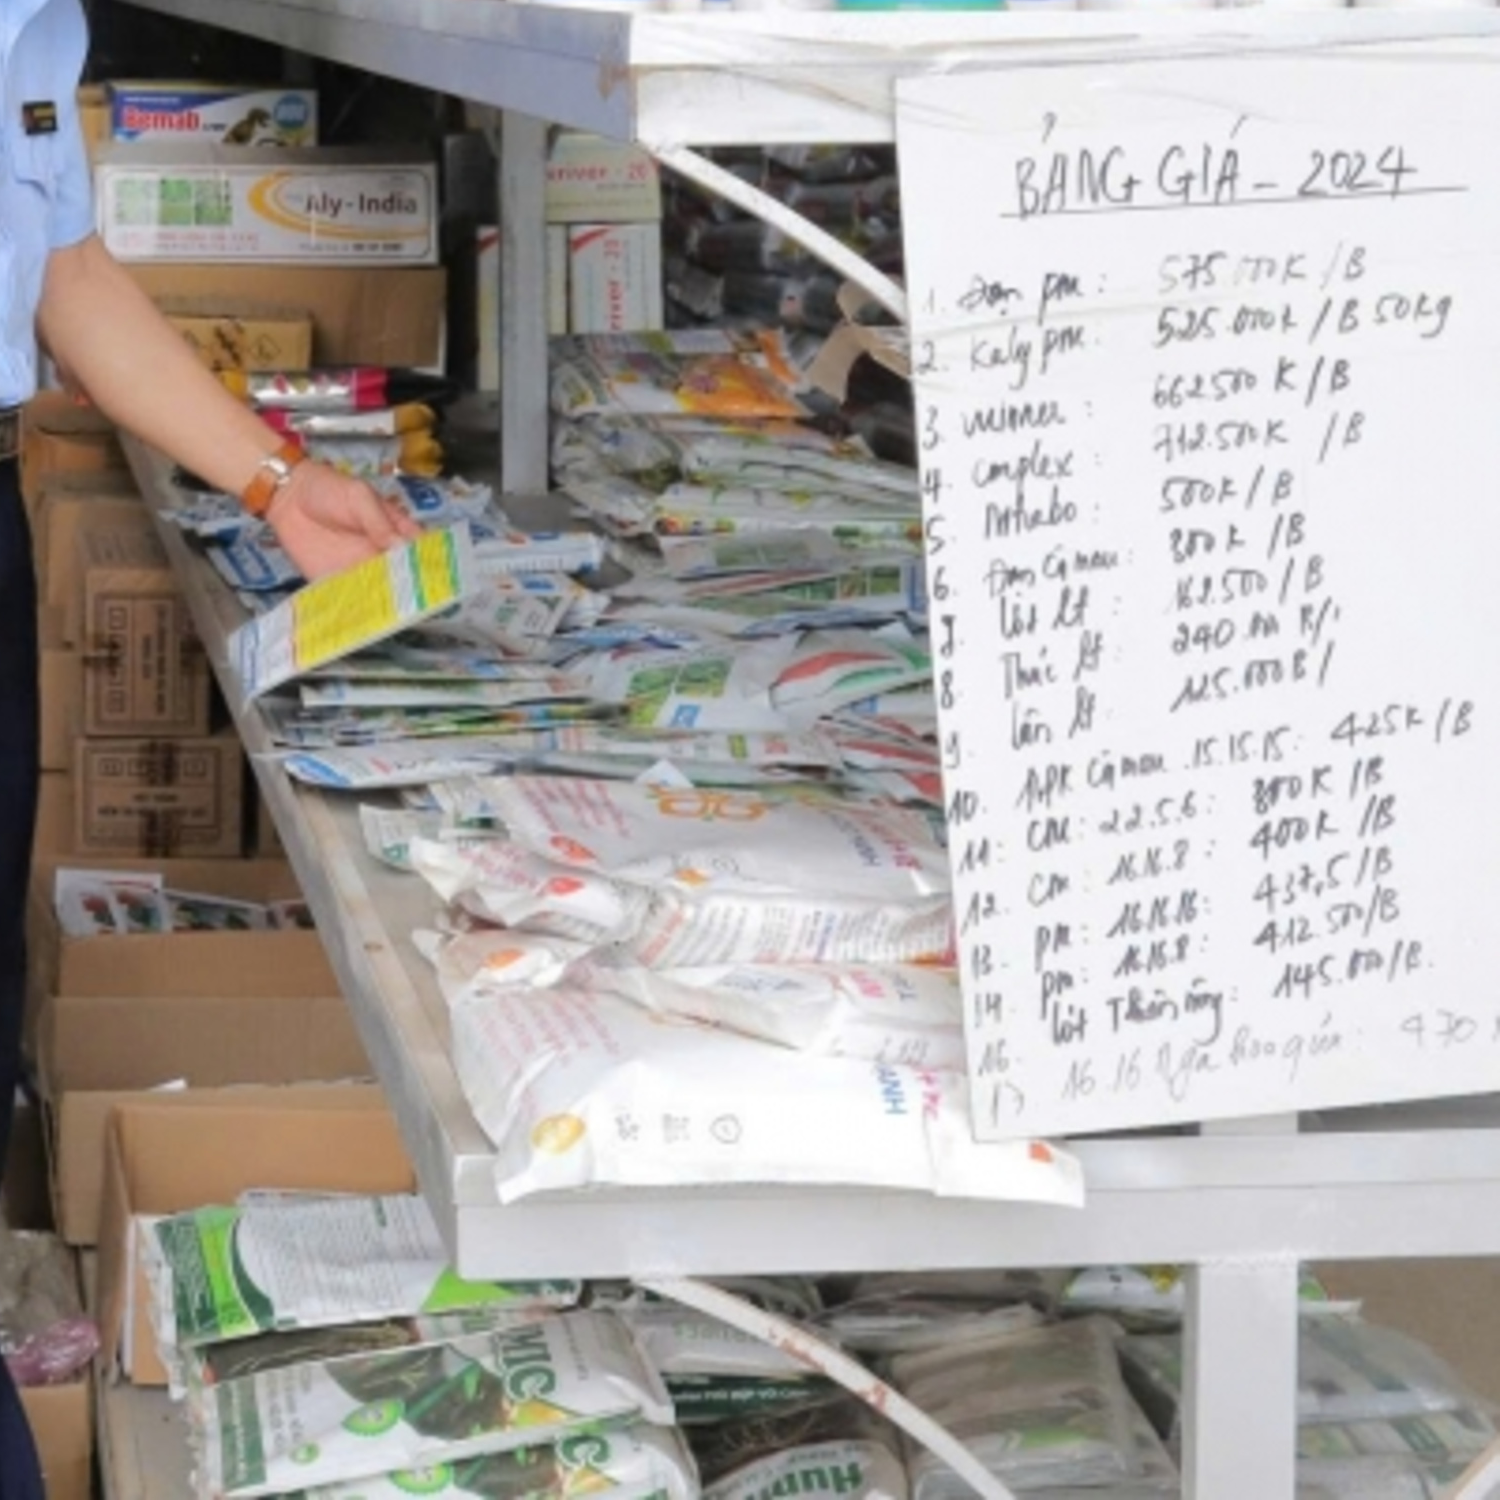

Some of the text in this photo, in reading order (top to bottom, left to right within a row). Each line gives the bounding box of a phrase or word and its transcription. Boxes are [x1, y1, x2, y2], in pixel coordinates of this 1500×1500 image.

[1015, 111, 1141, 220] BẢNG
[1157, 114, 1247, 205] GIÁ
[1297, 146, 1418, 200] 2024
[359, 189, 417, 214] India
